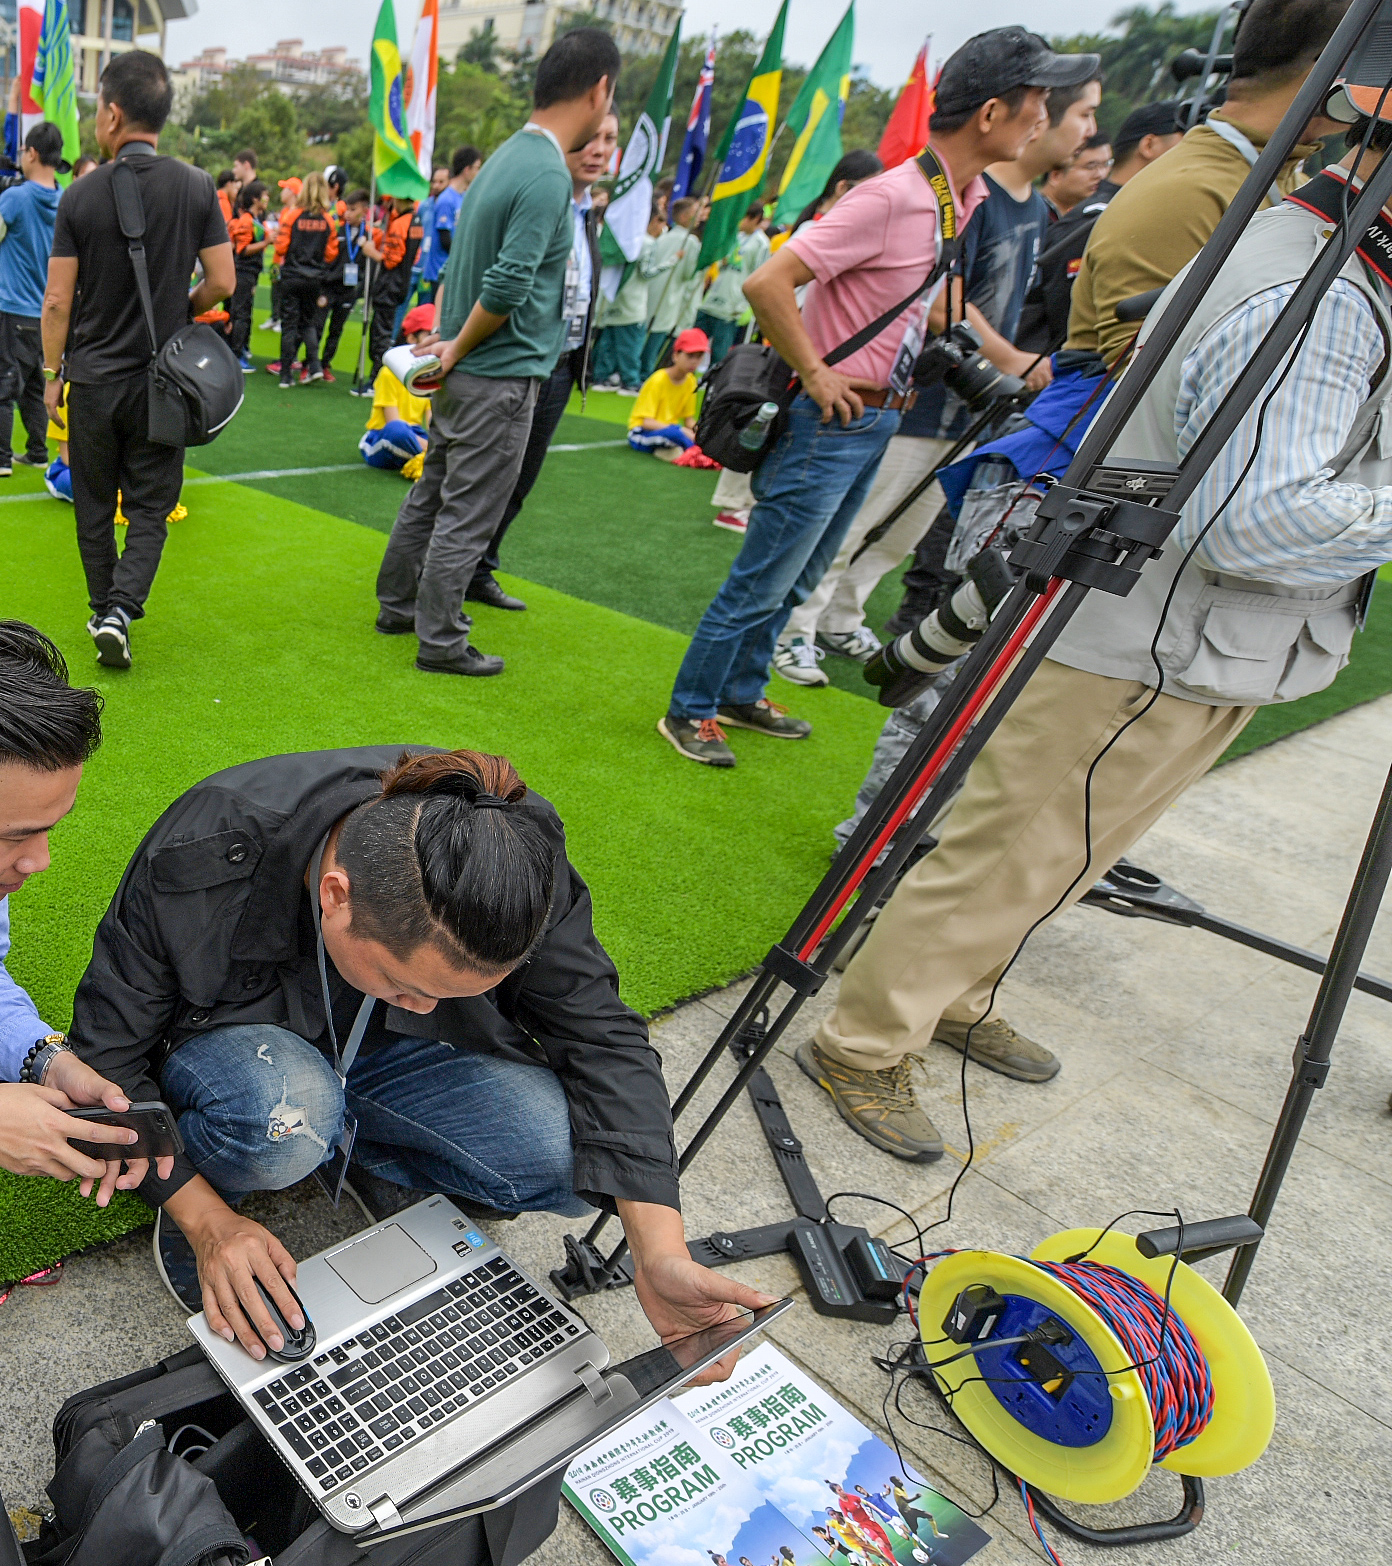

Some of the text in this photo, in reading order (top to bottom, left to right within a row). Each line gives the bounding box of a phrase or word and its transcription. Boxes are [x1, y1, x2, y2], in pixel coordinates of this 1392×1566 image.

[726, 1382, 807, 1441] 赛事指南
[730, 1402, 827, 1470] PROGRAM
[609, 1441, 702, 1505] 赛事指南
[620, 1443, 654, 1463] INTERNATIONAL
[608, 1463, 721, 1536] PROGRAM
